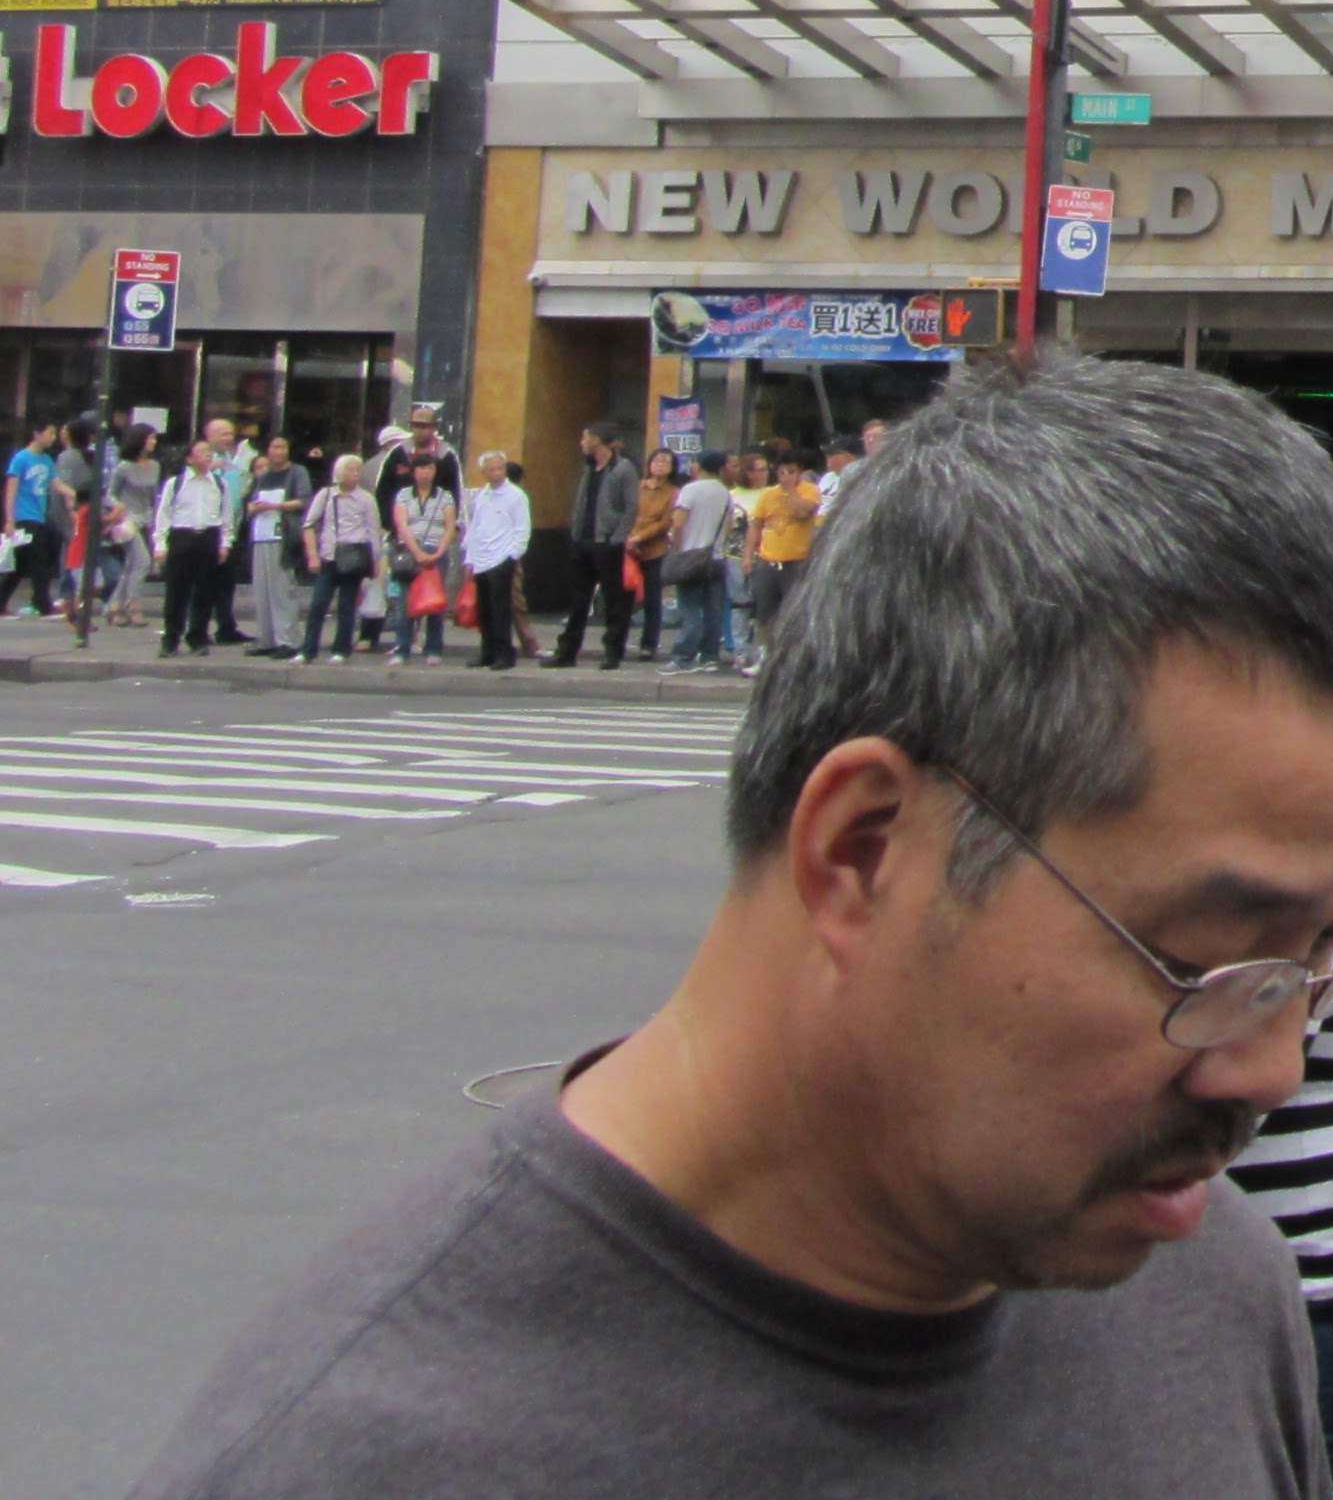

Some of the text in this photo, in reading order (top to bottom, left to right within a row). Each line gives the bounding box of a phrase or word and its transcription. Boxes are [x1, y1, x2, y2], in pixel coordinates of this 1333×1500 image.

[33, 20, 439, 138] Locker
[1082, 98, 1119, 117] MAIN
[562, 170, 793, 234] NEW
[845, 170, 1223, 238] WOLD
[1072, 190, 1091, 201] NO
[811, 300, 898, 337] 買1送1
